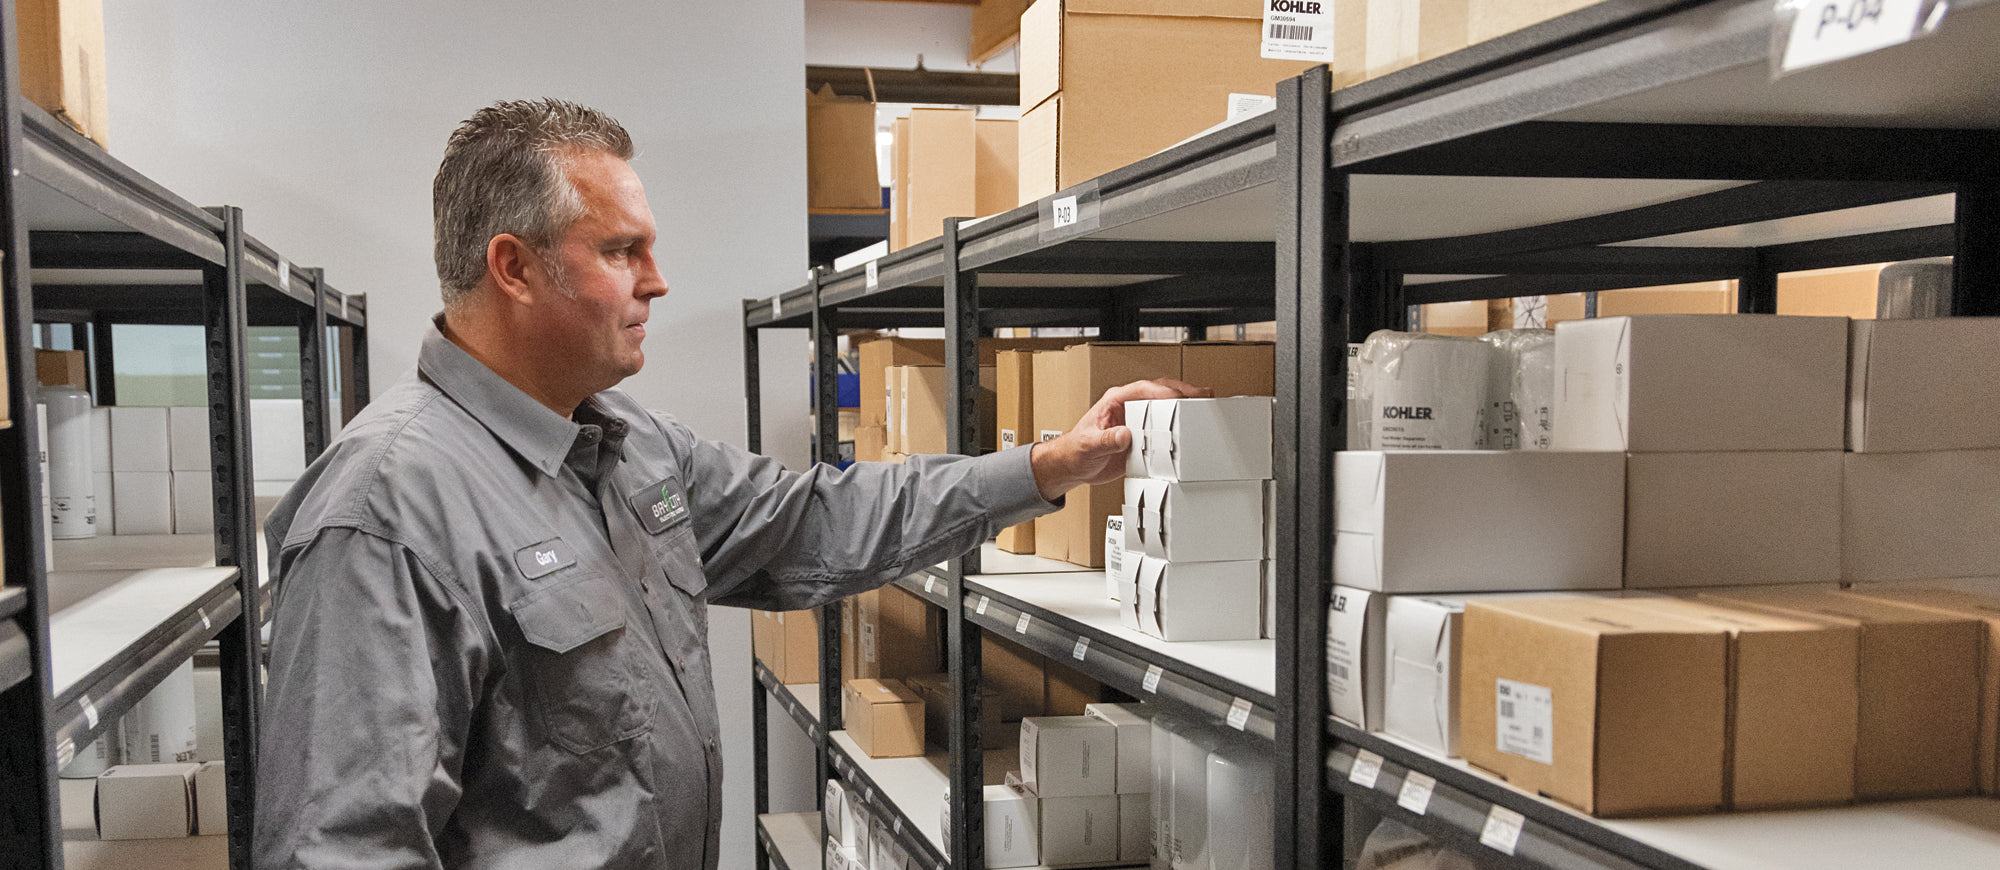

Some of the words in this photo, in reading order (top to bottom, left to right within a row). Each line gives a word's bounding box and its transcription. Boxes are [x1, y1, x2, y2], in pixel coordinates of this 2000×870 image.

[1270, 0, 1321, 15] KOHLER
[1057, 206, 1071, 224] P-03
[1383, 406, 1432, 420] KOHLER
[652, 500, 669, 518] BAY
[535, 550, 558, 566] Gary
